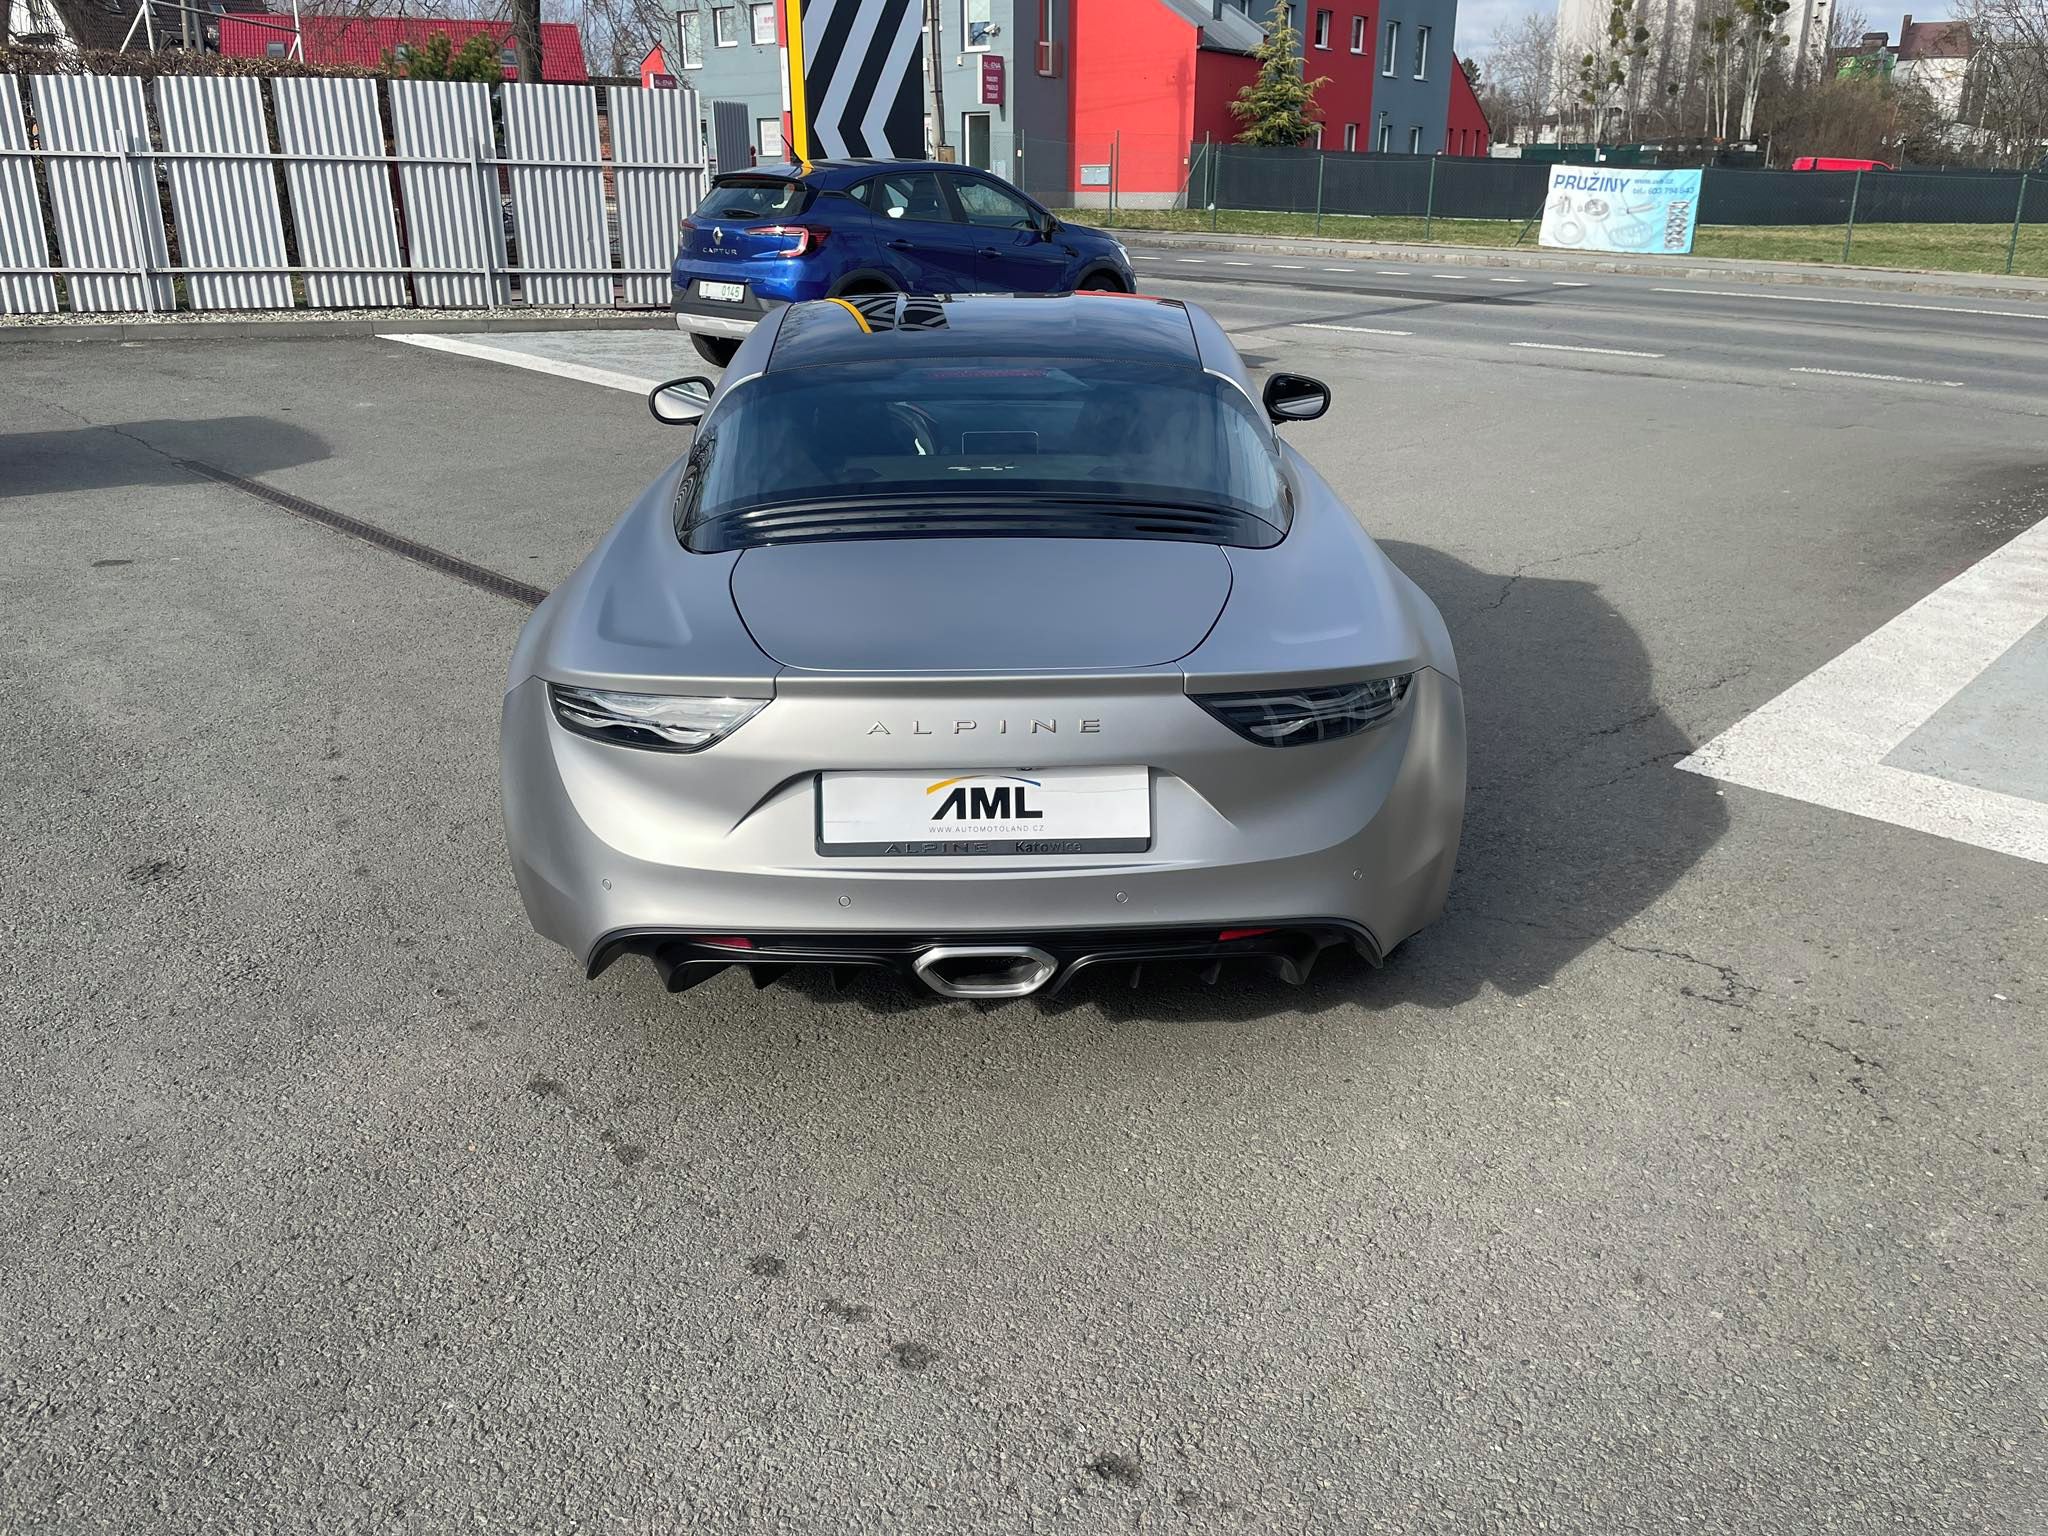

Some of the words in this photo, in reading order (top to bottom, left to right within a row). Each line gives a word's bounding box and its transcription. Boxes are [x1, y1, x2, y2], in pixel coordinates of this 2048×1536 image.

[1553, 171, 1631, 193] PRUŽINY
[702, 247, 738, 255] CAPTUR
[721, 285, 740, 297] 0145
[866, 718, 1101, 735] ALPINE
[930, 786, 1044, 820] AML
[928, 824, 1045, 833] WWW.AUTOMOTOLAND.CZ
[884, 842, 989, 854] ALPINE
[1015, 840, 1082, 853] Katowice
